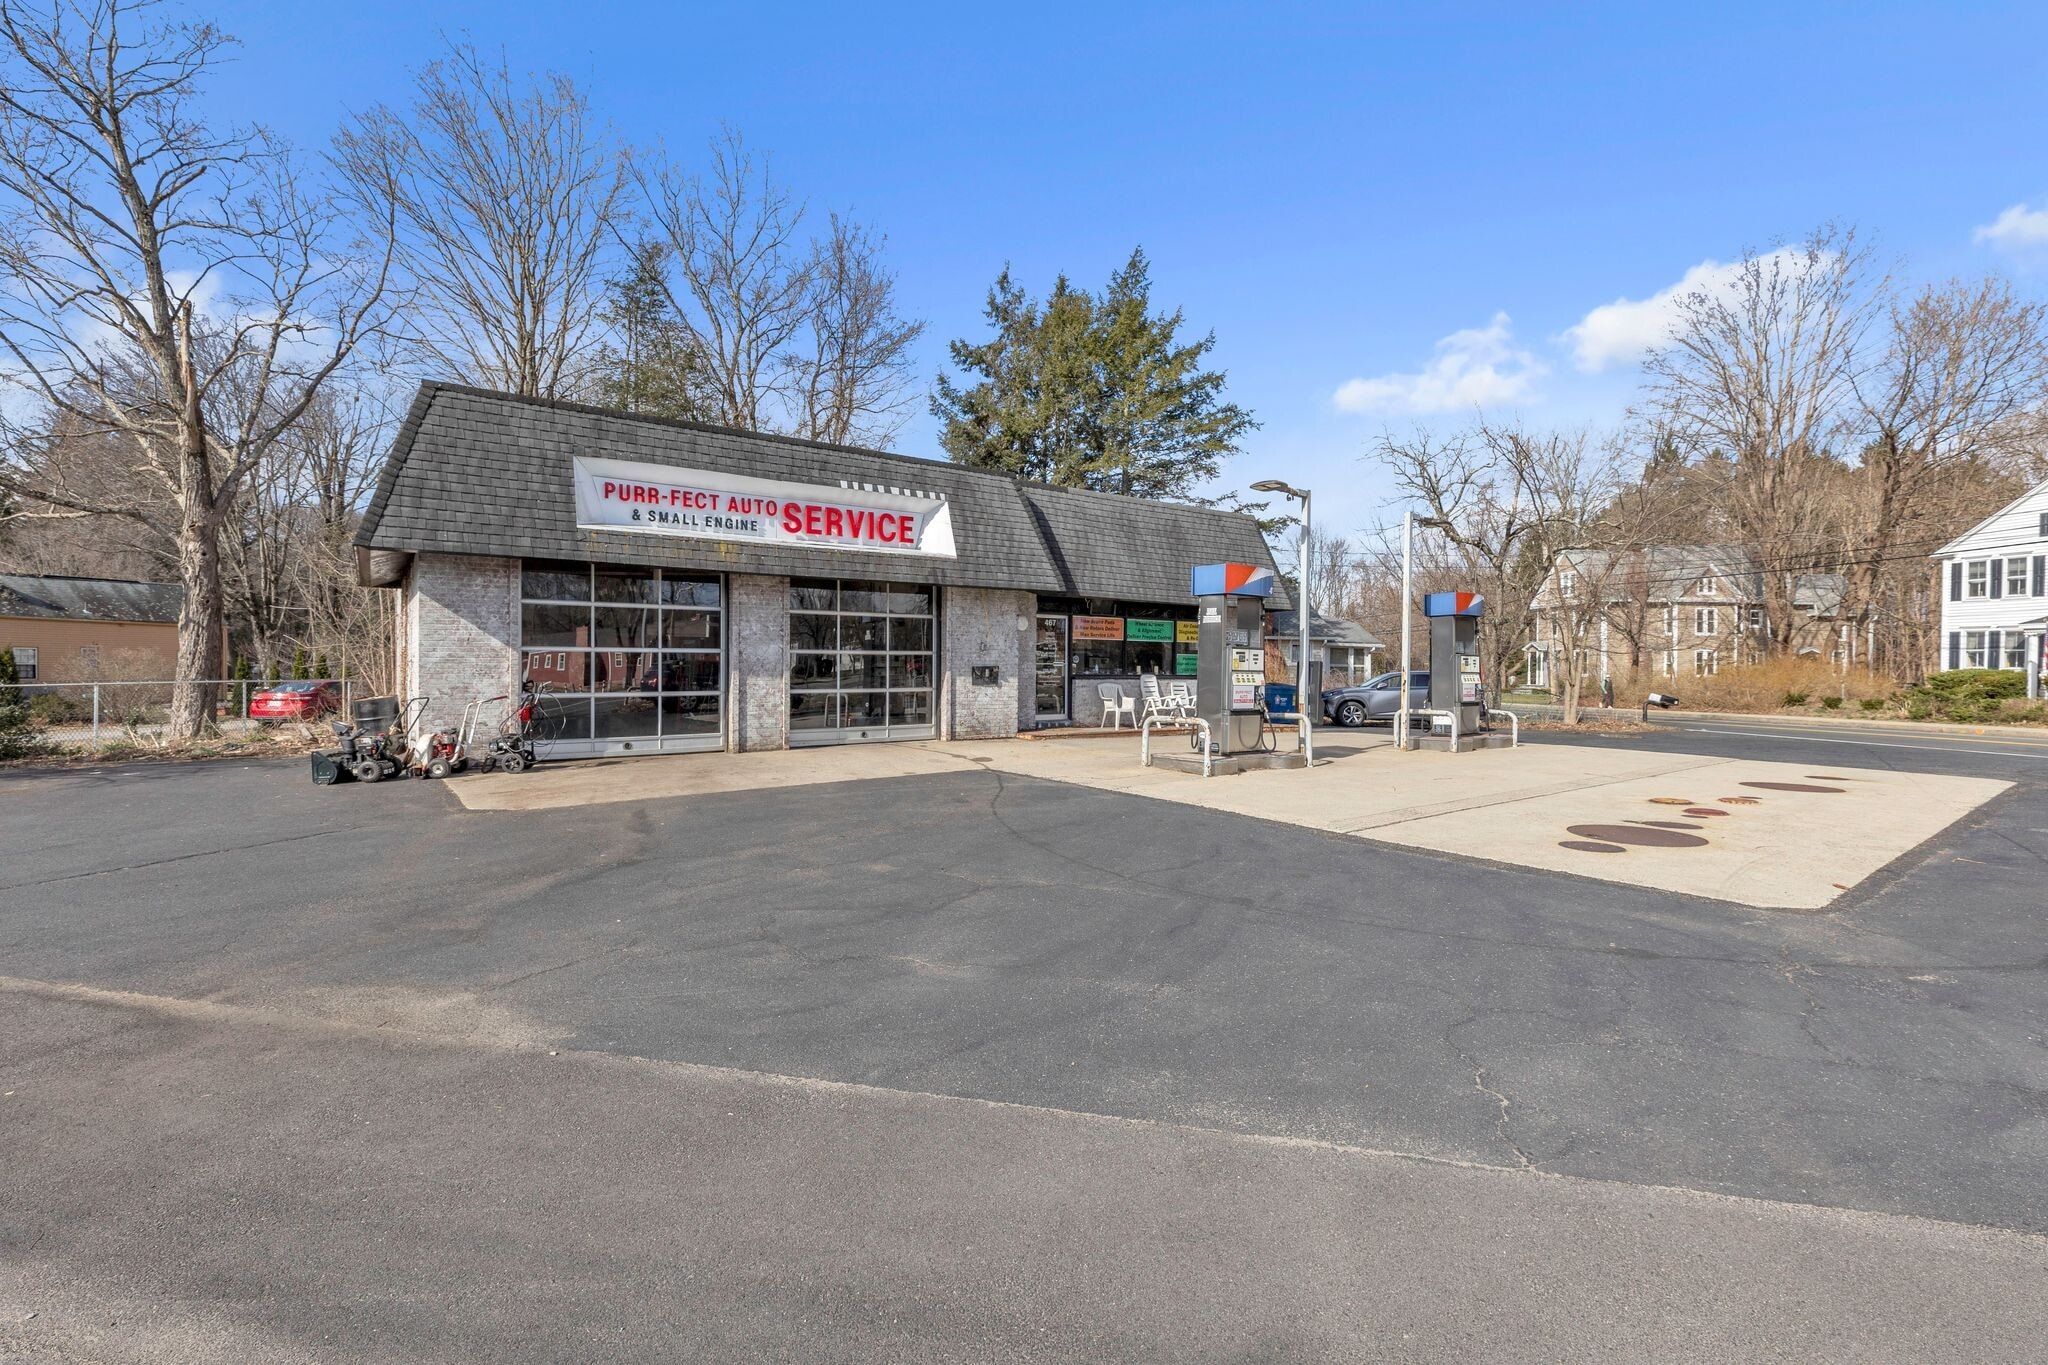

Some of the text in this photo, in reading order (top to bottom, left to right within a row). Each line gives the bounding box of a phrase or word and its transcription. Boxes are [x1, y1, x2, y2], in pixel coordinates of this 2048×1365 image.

[604, 481, 778, 516] PURR-FECT AUTO
[631, 508, 759, 532] & SMALL ENGINE
[782, 502, 915, 544] SERVICE
